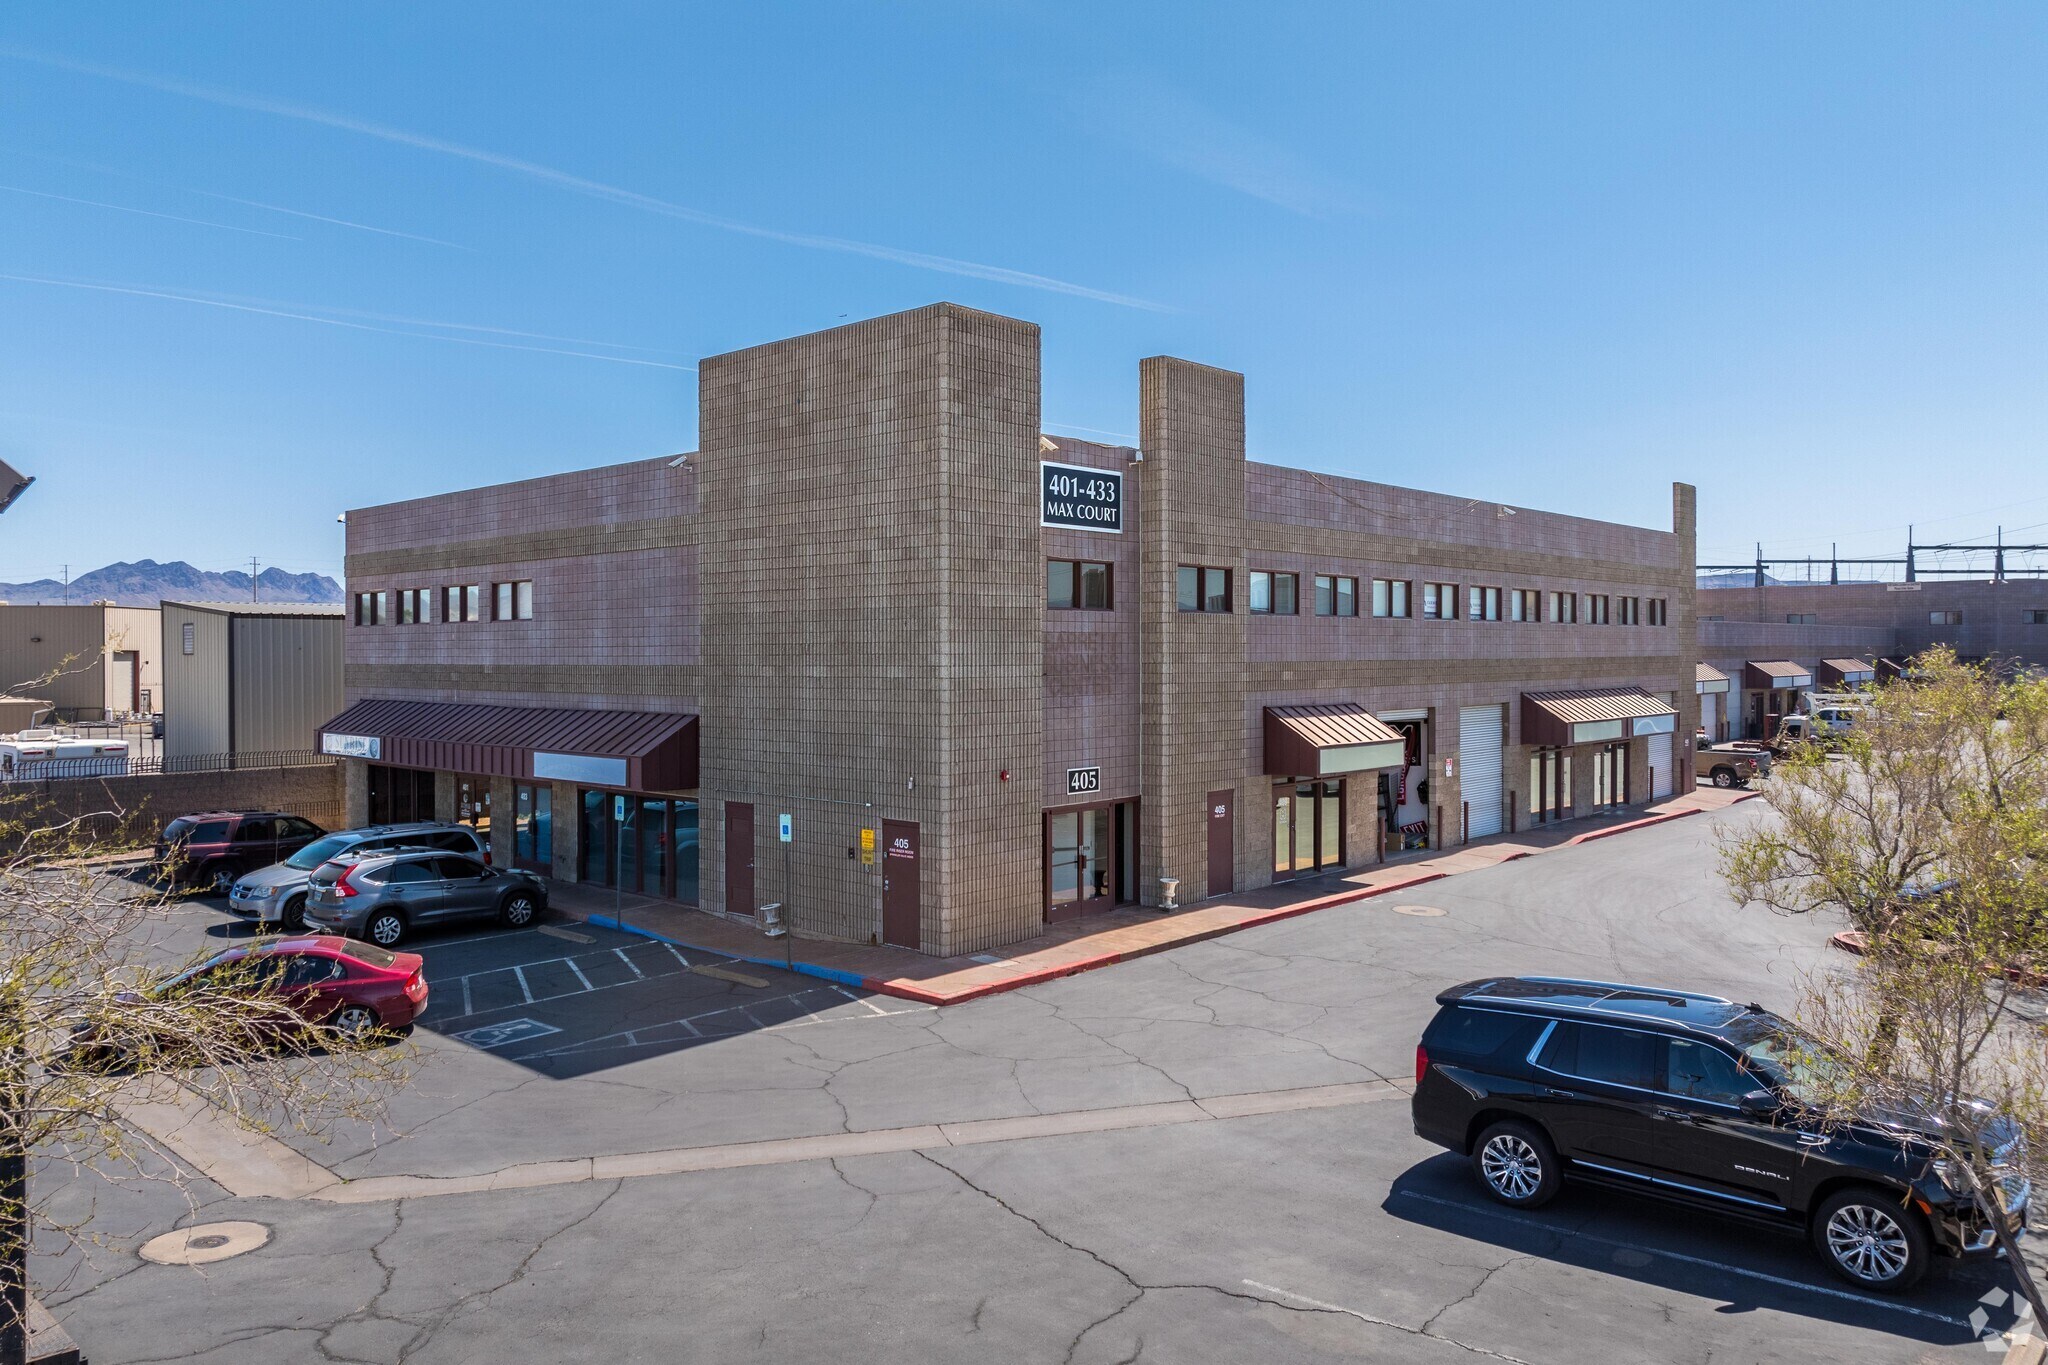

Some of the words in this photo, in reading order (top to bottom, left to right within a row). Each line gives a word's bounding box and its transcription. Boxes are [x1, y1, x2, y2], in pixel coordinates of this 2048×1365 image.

[1049, 474, 1115, 502] 401-433
[1047, 501, 1074, 518] MAX
[1076, 504, 1117, 522] COURT
[1071, 771, 1097, 790] 405
[894, 838, 909, 849] 405
[1734, 1164, 1790, 1181] DENALI
